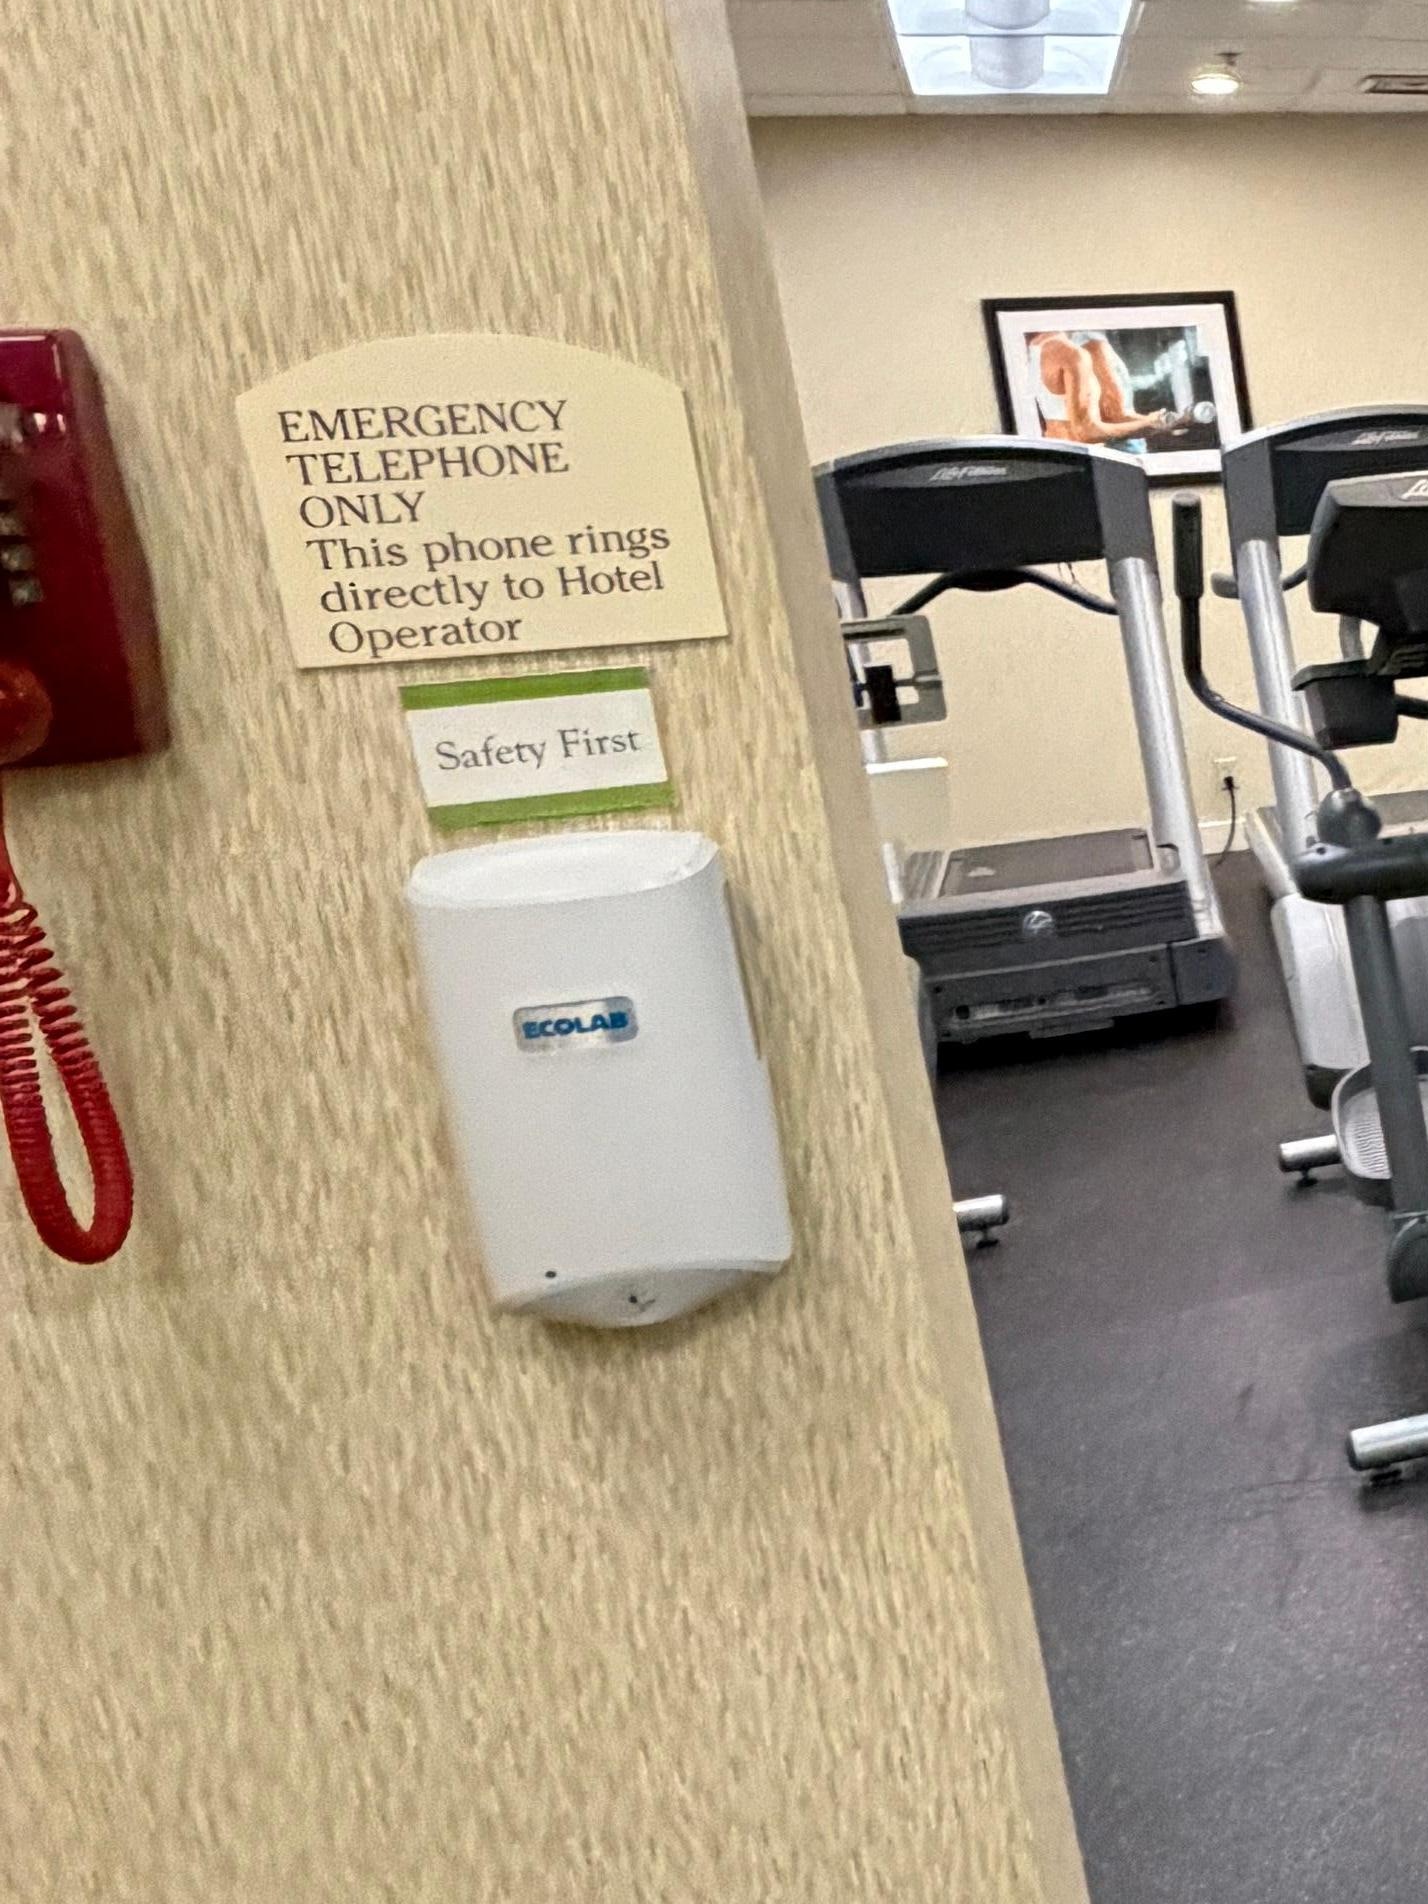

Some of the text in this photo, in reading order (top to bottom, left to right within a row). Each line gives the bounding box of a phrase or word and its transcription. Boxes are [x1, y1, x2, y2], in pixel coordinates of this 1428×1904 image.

[278, 400, 567, 444] EMERGENCY
[286, 442, 569, 487] TELEPHONE
[300, 491, 425, 529] ONLY
[305, 525, 671, 572] This phone rings
[320, 560, 665, 612] directly to Hotel
[328, 614, 523, 658] Operator
[436, 728, 641, 772] Safety First
[522, 1011, 629, 1039] ECOLAB
